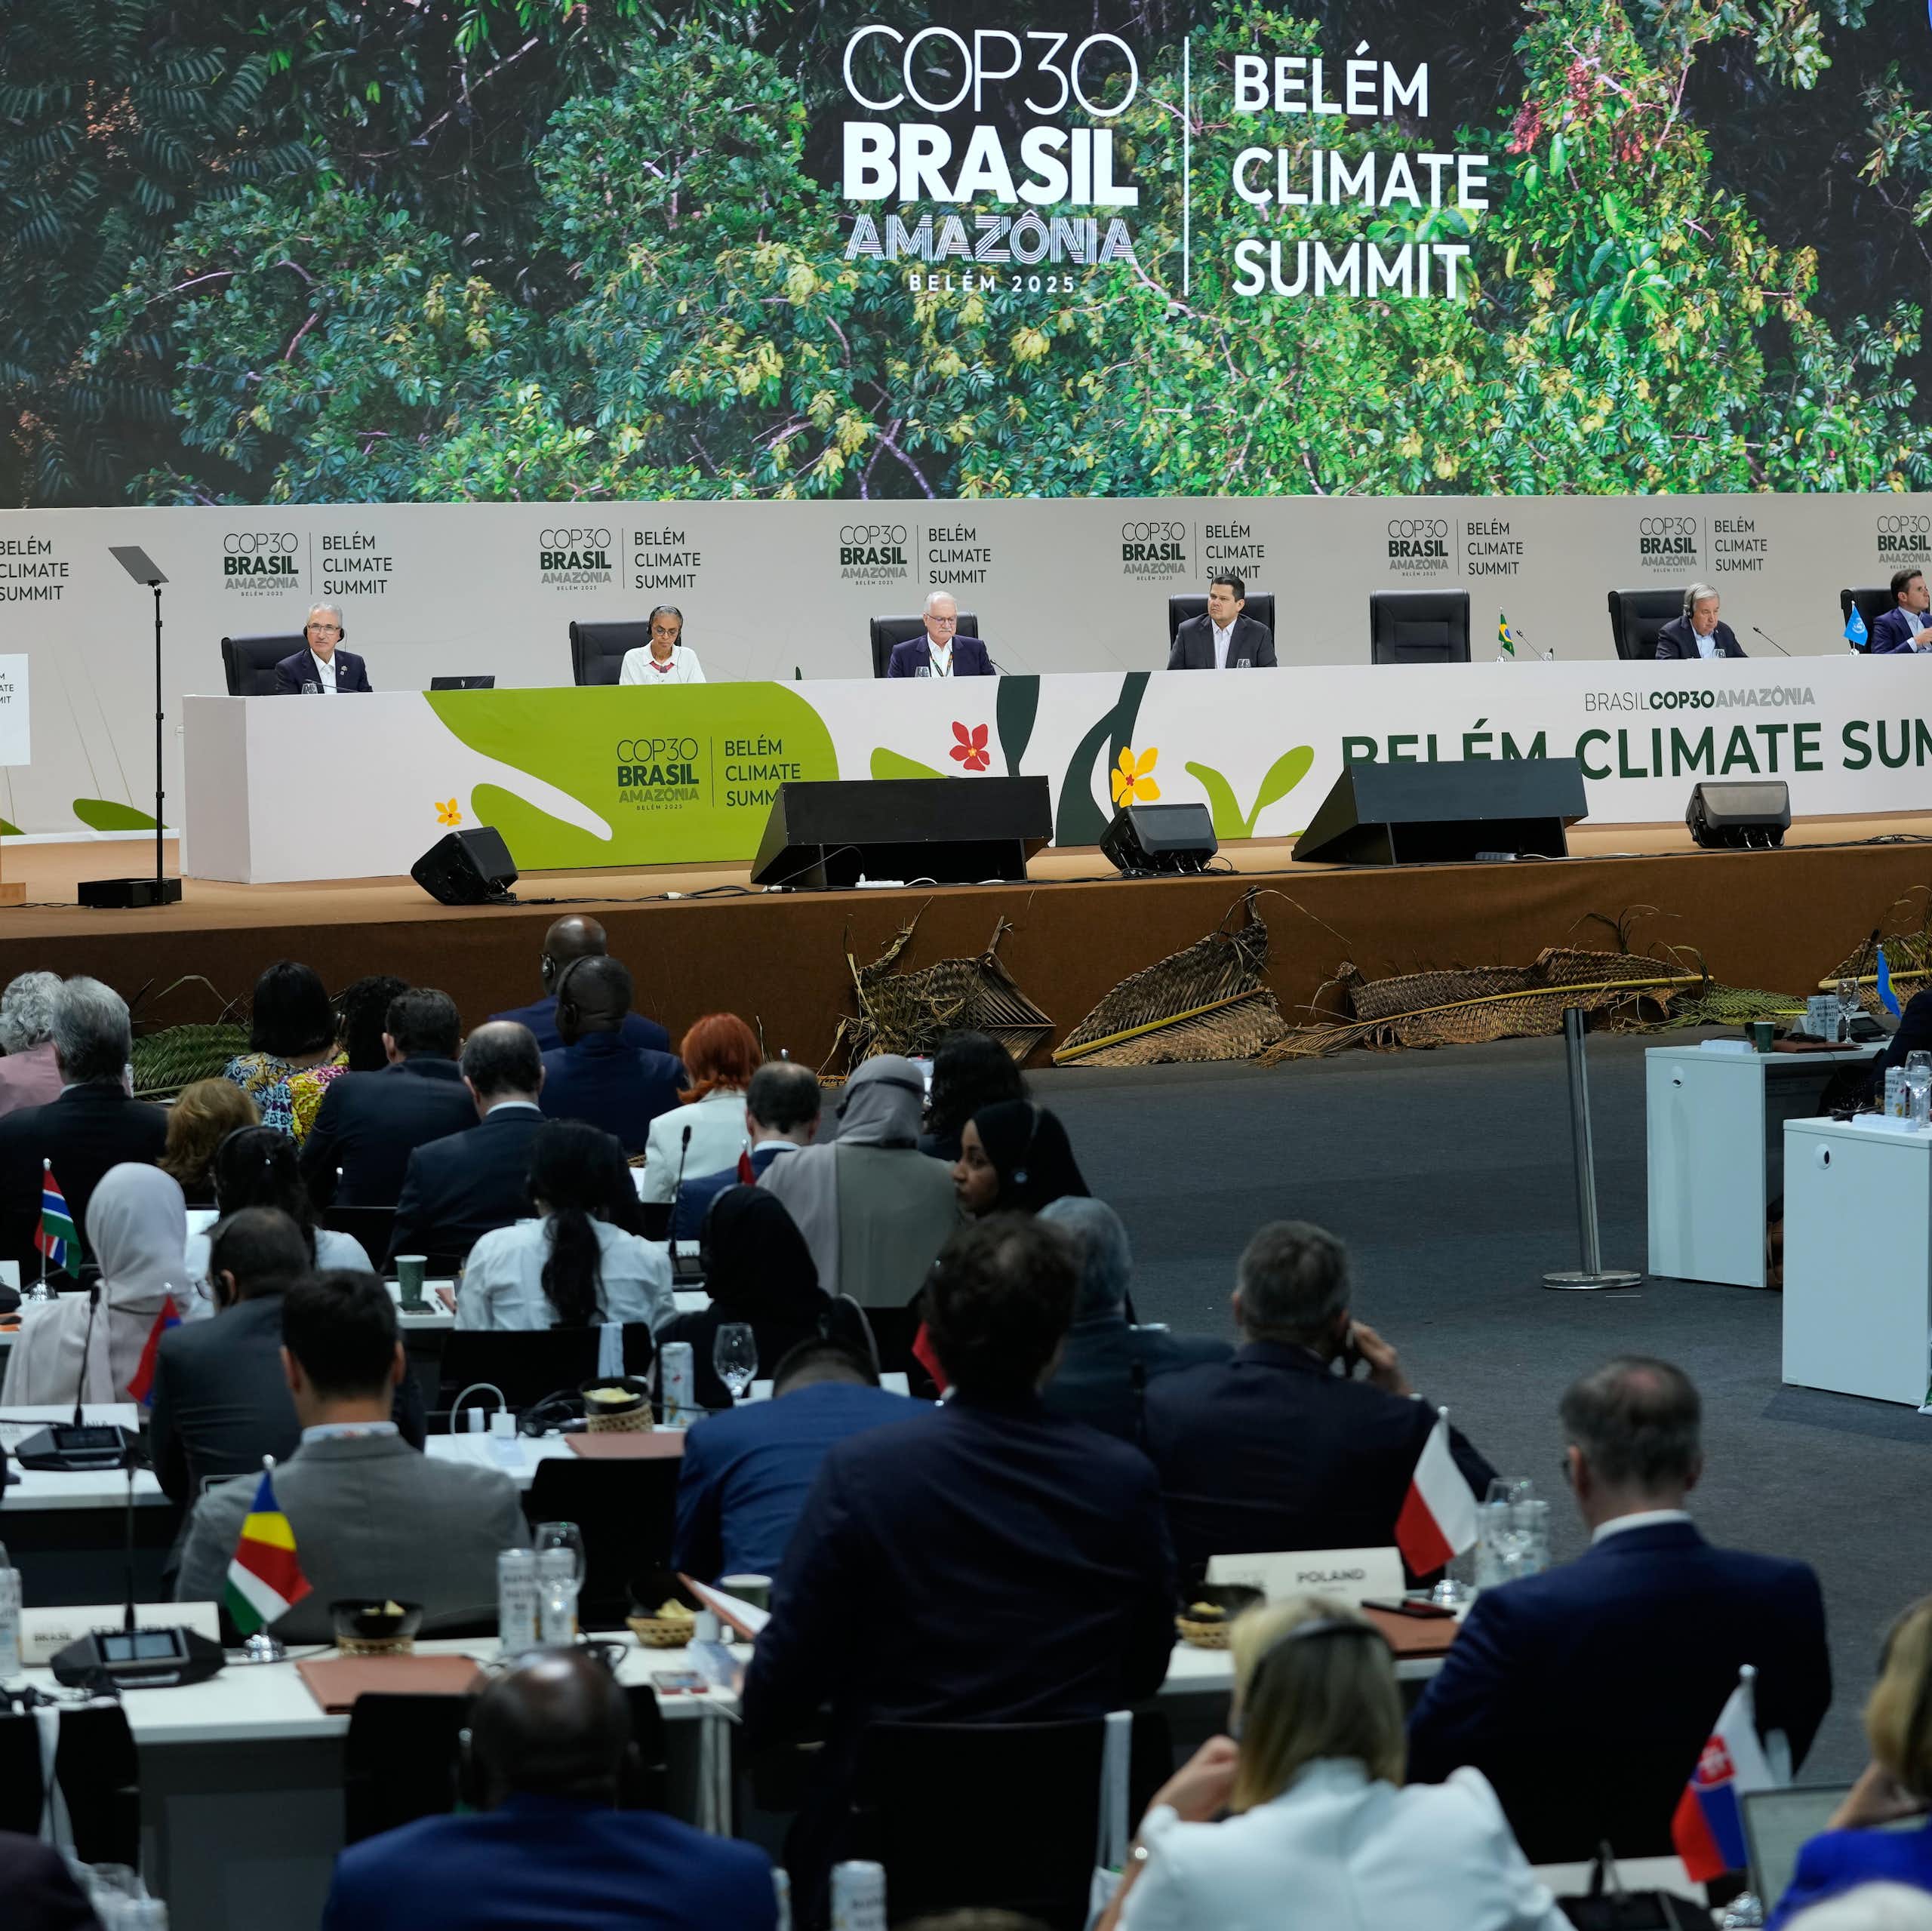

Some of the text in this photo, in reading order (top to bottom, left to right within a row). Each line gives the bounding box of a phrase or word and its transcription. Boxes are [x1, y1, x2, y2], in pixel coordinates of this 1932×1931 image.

[842, 24, 1139, 117] COP30
[1232, 39, 1429, 118] BELÉM
[842, 121, 1139, 206] BRASIL
[1232, 147, 1490, 210] CLIMATE
[843, 209, 1139, 264] AMAZÔNIA
[1232, 239, 1470, 300] SUMMIT
[909, 269, 1074, 293] BELÉM 2025
[928, 523, 977, 542] BELÉM
[1122, 521, 1186, 542] COP30
[1206, 521, 1251, 538] BELÉM
[1388, 519, 1448, 538] COP30
[1467, 518, 1510, 536] BELÉM
[1640, 517, 1697, 536] COP30
[1715, 516, 1755, 533] BELÉM
[1877, 515, 1930, 533] COP30
[223, 532, 299, 555] COP30
[322, 531, 376, 550] BELÉM
[540, 528, 611, 549] COP30
[635, 527, 685, 546] BELÉM
[840, 524, 907, 546] COP30
[1877, 534, 1931, 551] BRASIL
[1122, 543, 1186, 561] BRASIL
[1206, 545, 1265, 559] CLIMATE
[1388, 540, 1449, 558] BRASIL
[1467, 542, 1524, 555] CLIMATE
[1640, 537, 1697, 554] BRASIL
[1715, 539, 1767, 552] CLIMATE
[323, 557, 393, 572] CLIMATE
[540, 550, 612, 570] BRASIL
[635, 552, 701, 567] CLIMATE
[840, 546, 908, 565] BRASIL
[928, 549, 992, 563] CLIMATE
[1389, 558, 1450, 570] AMAZÔNIA
[1641, 555, 1697, 567] AMAZÔNIA
[1878, 552, 1931, 564] AMAZÔNIA
[223, 555, 299, 575] BRASIL
[841, 565, 908, 579] AMAZÔNIA
[1123, 561, 1186, 574] AMAZÔNIA
[1468, 561, 1519, 575] SUMMIT
[1715, 558, 1764, 572] SUMMIT
[225, 576, 299, 589] AMAZÔNIA
[541, 570, 612, 583] AMAZÔNIA
[635, 574, 697, 589] SUMMIT
[929, 570, 987, 584] SUMMIT
[323, 580, 388, 595] SUMMIT
[617, 737, 699, 763] COP30
[724, 734, 783, 757] BELÉM
[1575, 722, 1823, 780] CLIMATE
[617, 763, 700, 787] BRASIL
[725, 763, 801, 782] CLIMATE
[619, 786, 700, 804] AMAZÔNIA
[726, 789, 778, 807] SUMM
[1297, 1568, 1367, 1584] POLAND
